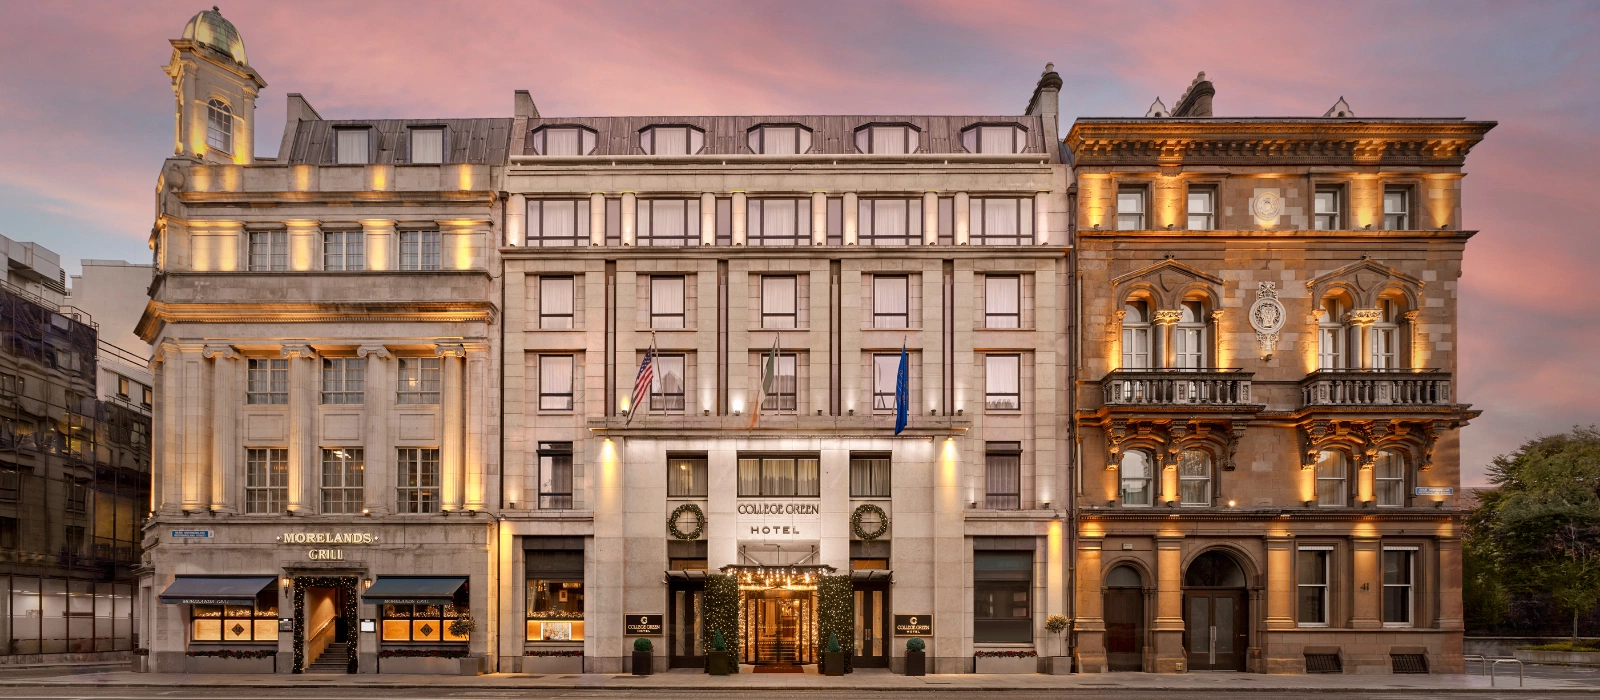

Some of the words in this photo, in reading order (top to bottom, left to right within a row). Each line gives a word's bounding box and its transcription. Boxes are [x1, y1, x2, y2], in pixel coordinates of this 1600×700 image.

[738, 504, 784, 515] COLLEGE
[785, 504, 819, 515] GREEN
[751, 526, 799, 534] HOTEL
[283, 533, 374, 543] MORELANDS
[308, 549, 344, 560] GRILL
[1360, 582, 1369, 591] 41
